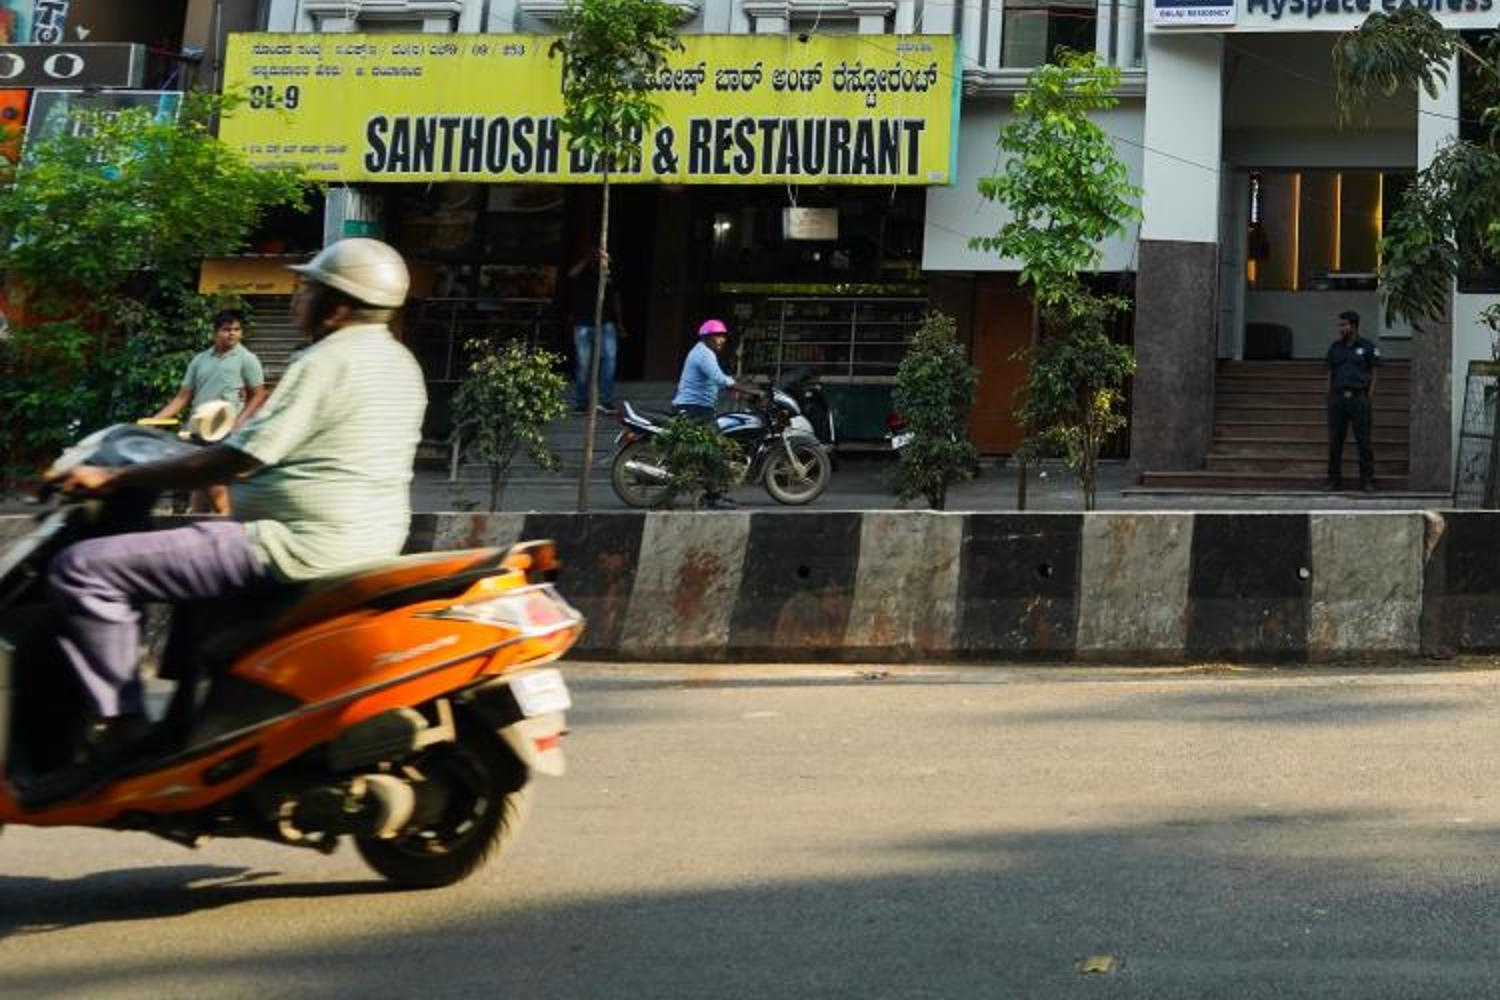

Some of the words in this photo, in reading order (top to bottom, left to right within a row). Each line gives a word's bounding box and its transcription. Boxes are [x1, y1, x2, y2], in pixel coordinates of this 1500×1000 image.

[715, 62, 763, 91] ಬಾರ್
[772, 62, 822, 92] ಅಂಡ್
[365, 116, 559, 174] SANTHOSH
[653, 126, 677, 173] &
[689, 118, 924, 175] RESTAURANT
